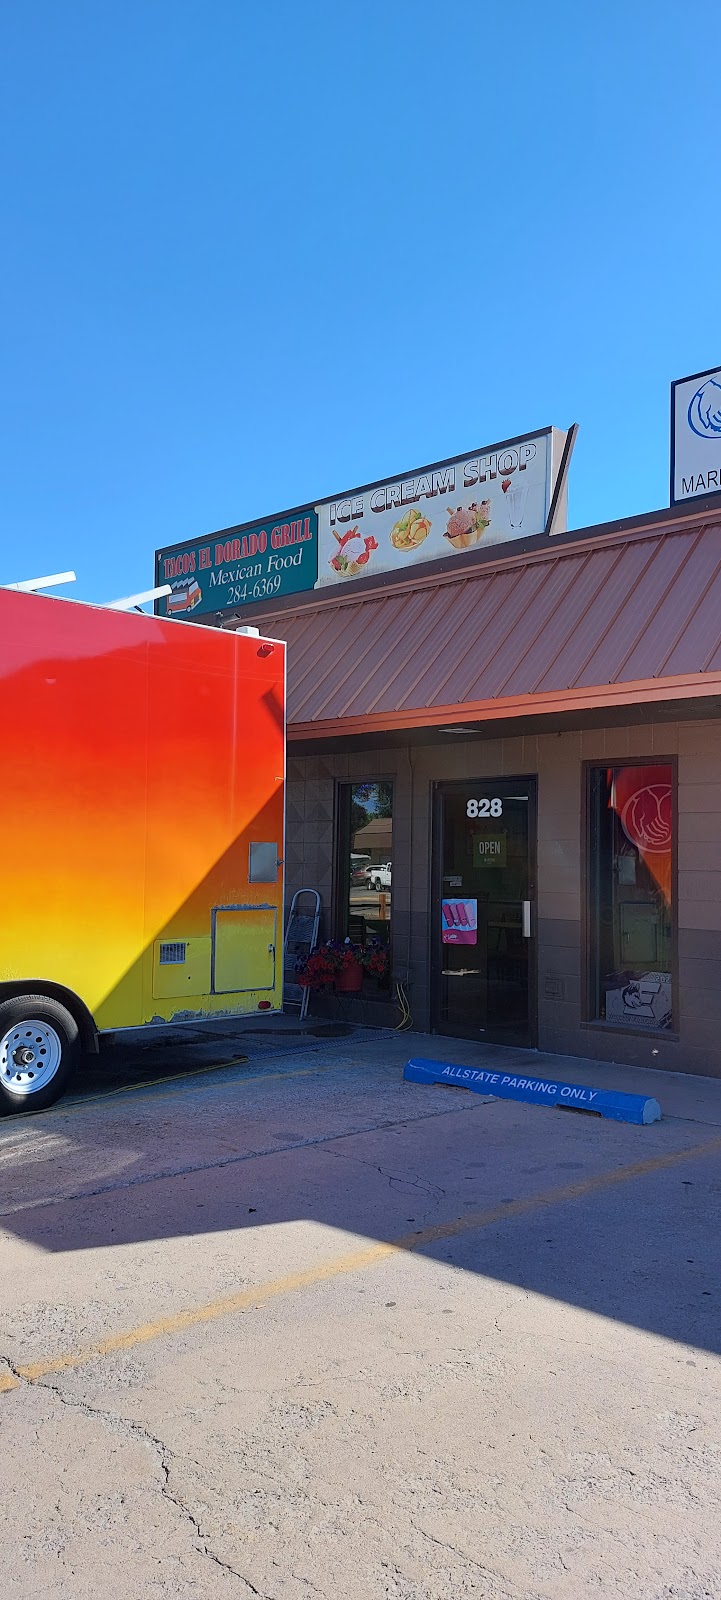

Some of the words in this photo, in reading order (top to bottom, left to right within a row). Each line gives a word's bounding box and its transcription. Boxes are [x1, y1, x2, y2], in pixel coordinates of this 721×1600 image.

[329, 496, 362, 526] ICE
[371, 468, 455, 513] CREAM
[464, 443, 537, 487] SHOP
[682, 468, 721, 495] MAR
[164, 551, 196, 579] TACOS
[199, 547, 212, 568] EL
[215, 531, 267, 563] DORADO
[271, 517, 312, 549] GRILL
[209, 563, 262, 588] Mexican
[267, 548, 303, 573] Food
[226, 575, 281, 605] 284-6369
[466, 798, 503, 818] 828
[479, 841, 501, 854] OPEN
[442, 1066, 500, 1084] ALLSTATE
[501, 1075, 557, 1094] PARKING
[560, 1087, 597, 1102] ONLY
